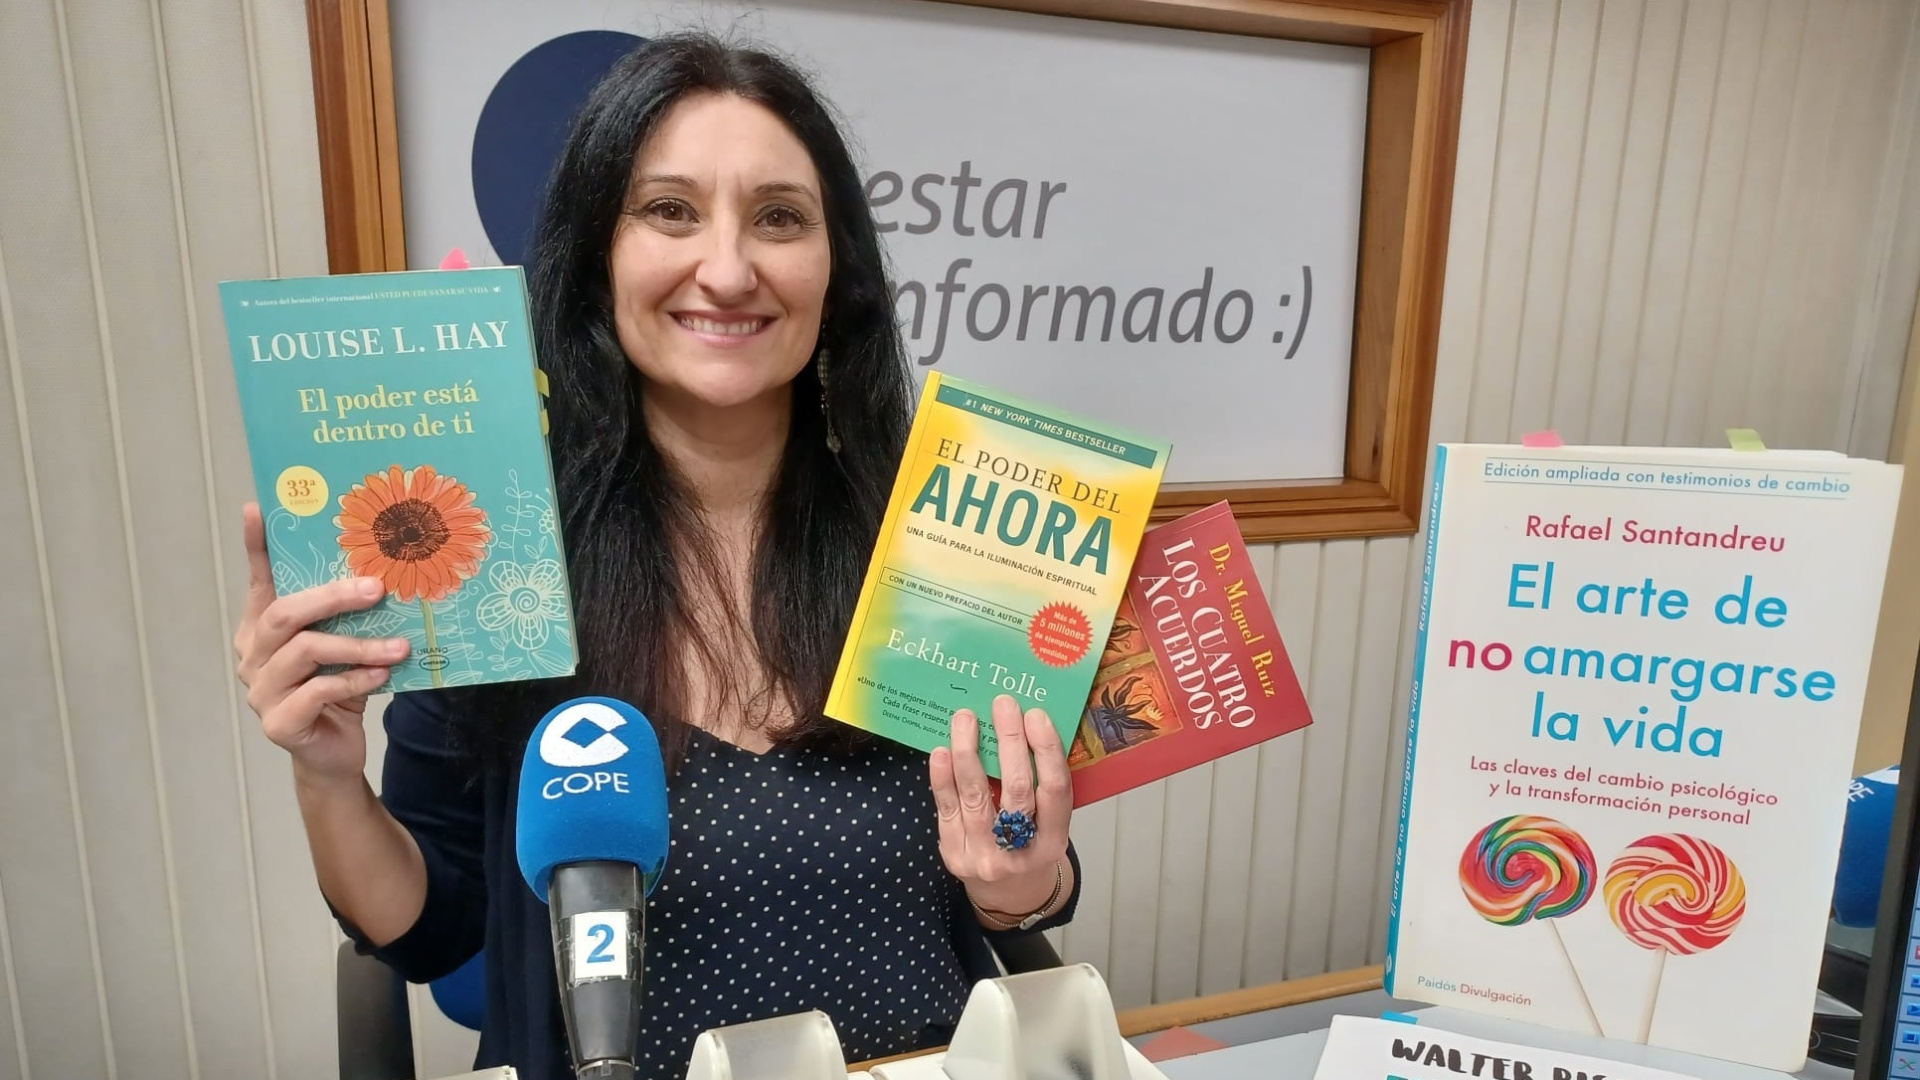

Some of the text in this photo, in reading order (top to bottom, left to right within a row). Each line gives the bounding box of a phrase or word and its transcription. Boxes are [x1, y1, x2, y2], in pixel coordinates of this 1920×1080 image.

[864, 160, 1067, 239] estar
[888, 258, 1253, 366] nformado
[248, 320, 510, 363] LOUISE L. HAY
[297, 378, 479, 419] El poder está
[312, 410, 476, 445] dentro de ti
[965, 398, 1126, 456] #1 NEW YORK TIMES BESTSELLER
[936, 437, 1122, 514] EL PODER DEL
[1484, 462, 1851, 494] Edición ampliada con testimonios de cambio
[910, 463, 1113, 576] AHORA
[1525, 514, 1786, 553] Rafael Santandreu
[907, 525, 1098, 596] UNA GUÍA PARA LA ILUMINACIÓN ESPIRITUAL
[1418, 482, 1440, 632] Rafael Santandreu
[888, 574, 1023, 625] CON UN NUEVO PREFACIO DEL AUTOR
[1208, 542, 1278, 698] Dr. Miguel Ruiz
[1507, 561, 1789, 629] El arte de
[1040, 617, 1086, 641] 5 millones
[1138, 574, 1223, 730] ACUERDOS
[1162, 536, 1257, 729] LOS CUATRO
[885, 628, 1048, 702] Eckhart Tolle
[1448, 638, 1837, 703] no amargarse
[877, 683, 886, 692] de
[887, 686, 898, 696] los
[899, 691, 927, 707] mejores
[928, 700, 948, 714] libros
[882, 696, 901, 709] Cada
[902, 701, 920, 716] frase
[921, 711, 949, 726] resuena
[1411, 680, 1419, 712] vida
[1530, 691, 1724, 758] la vida
[541, 772, 630, 801] COPE
[1470, 755, 1779, 807] Las claves del cambio psicológico
[1489, 780, 1751, 825] y la transformación personal
[586, 923, 616, 964] 2
[1417, 975, 1532, 1006] Paidós Divulgación
